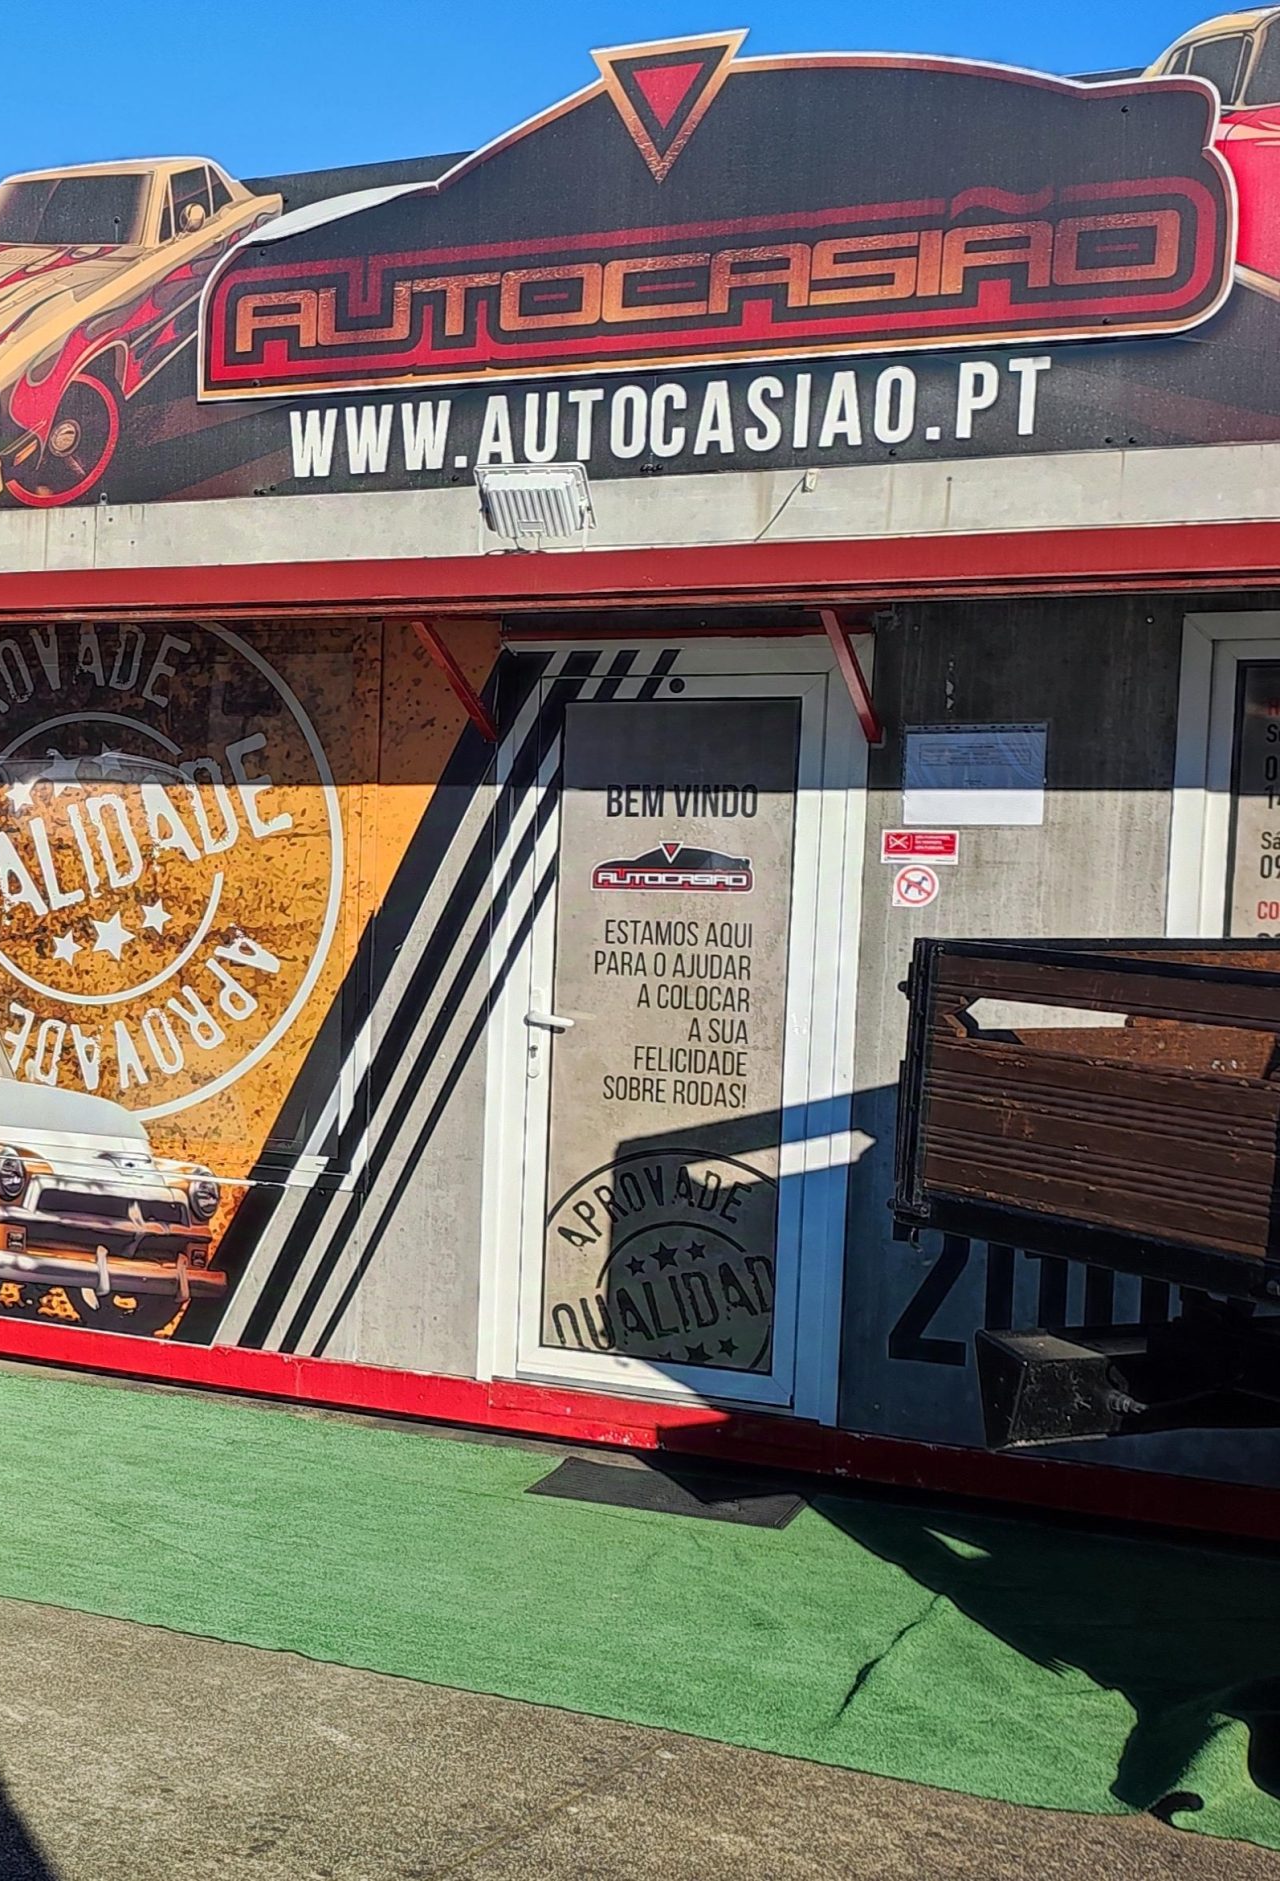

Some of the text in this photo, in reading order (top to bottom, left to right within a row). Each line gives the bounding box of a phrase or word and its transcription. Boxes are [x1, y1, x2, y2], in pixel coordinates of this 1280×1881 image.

[289, 355, 1052, 479] WWW.AUTOCASIAO.PT
[606, 784, 758, 818] BEM VINDO
[605, 919, 752, 948] ESTAMOS AQUI
[594, 951, 751, 980] PARA O AJUDAR
[637, 984, 750, 1013] A COLOCAR
[688, 1018, 748, 1044] A SUA
[634, 1046, 747, 1077] FELICIDADE
[603, 1075, 747, 1109] SOBRE RODAS!
[557, 1165, 752, 1250] APROVADE
